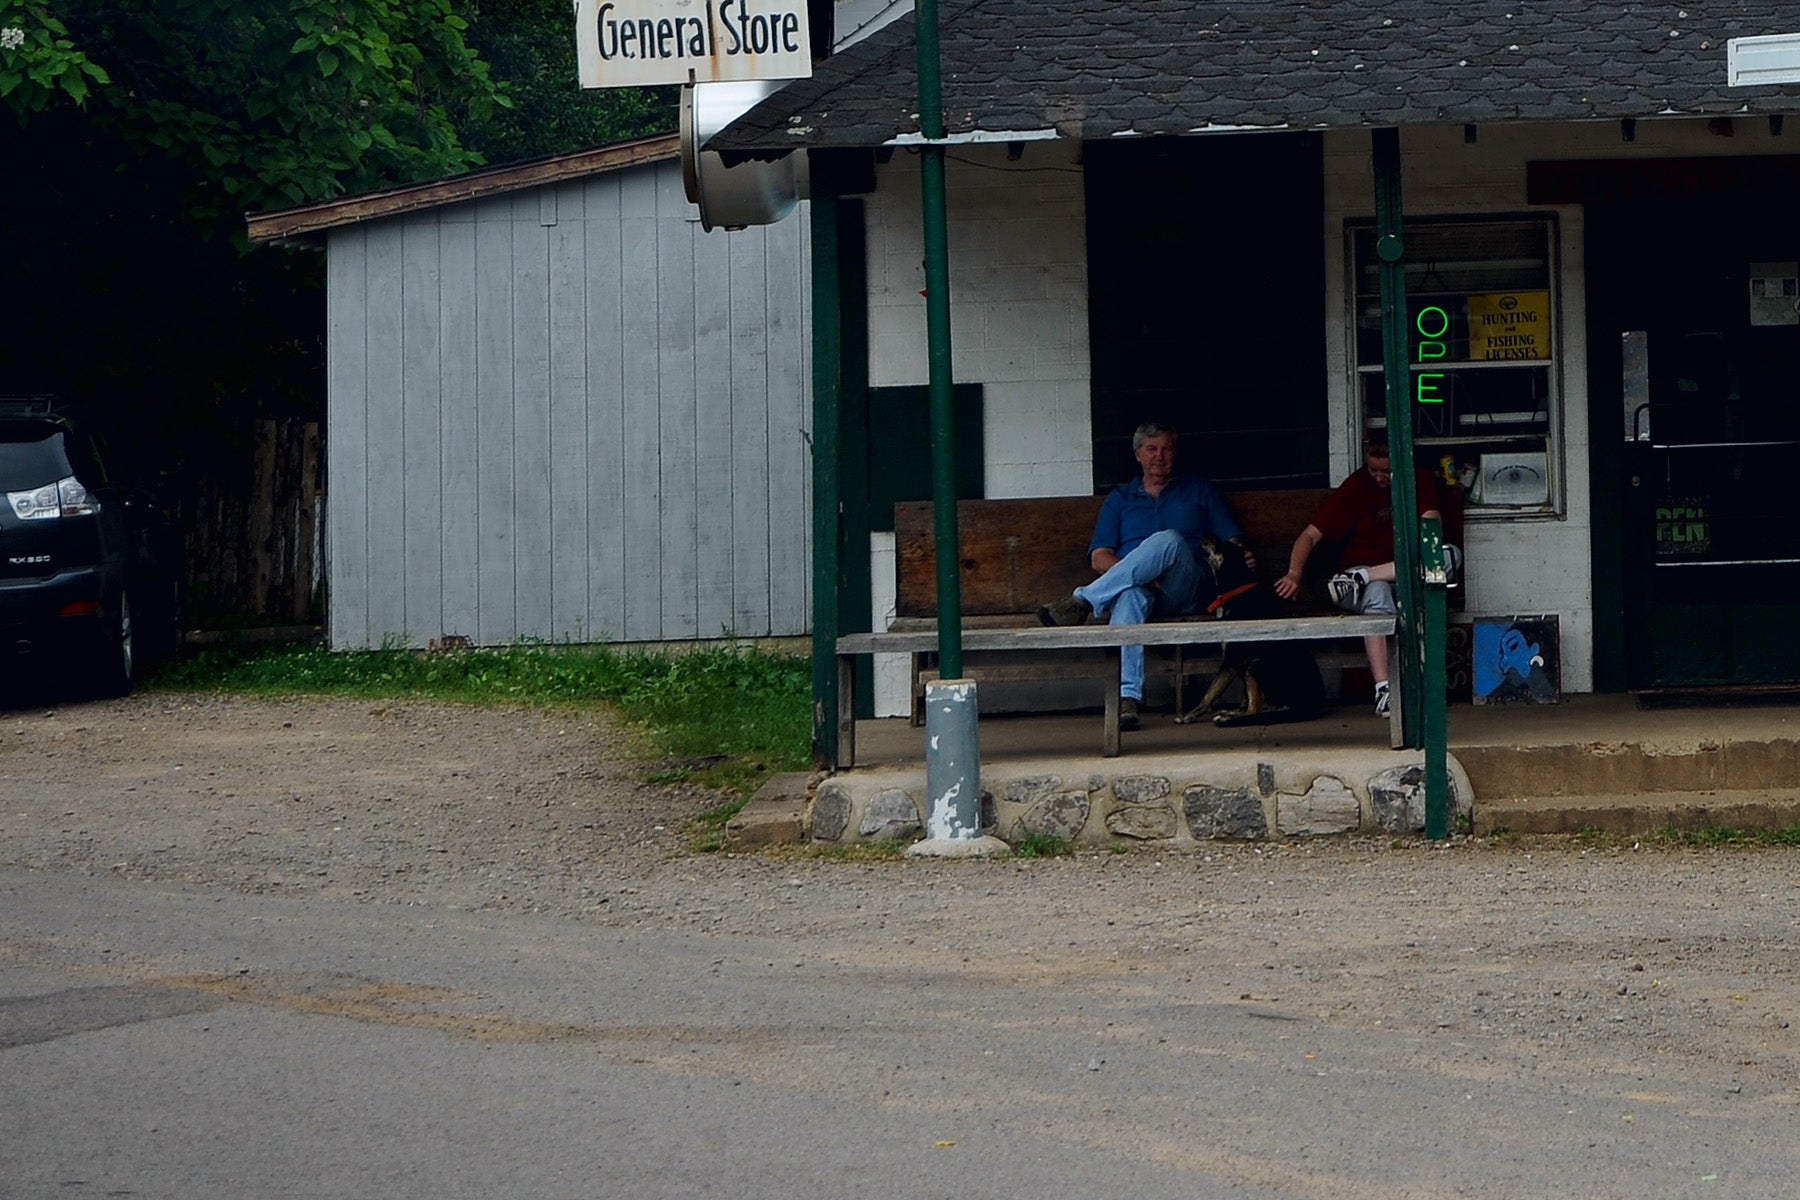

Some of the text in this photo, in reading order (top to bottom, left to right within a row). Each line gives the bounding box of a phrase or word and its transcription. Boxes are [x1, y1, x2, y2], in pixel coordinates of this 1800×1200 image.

[597, 0, 799, 60] General Store
[1482, 311, 1537, 326] HUNTING
[1487, 334, 1535, 348] FISHING
[1484, 346, 1538, 360] LICENSES
